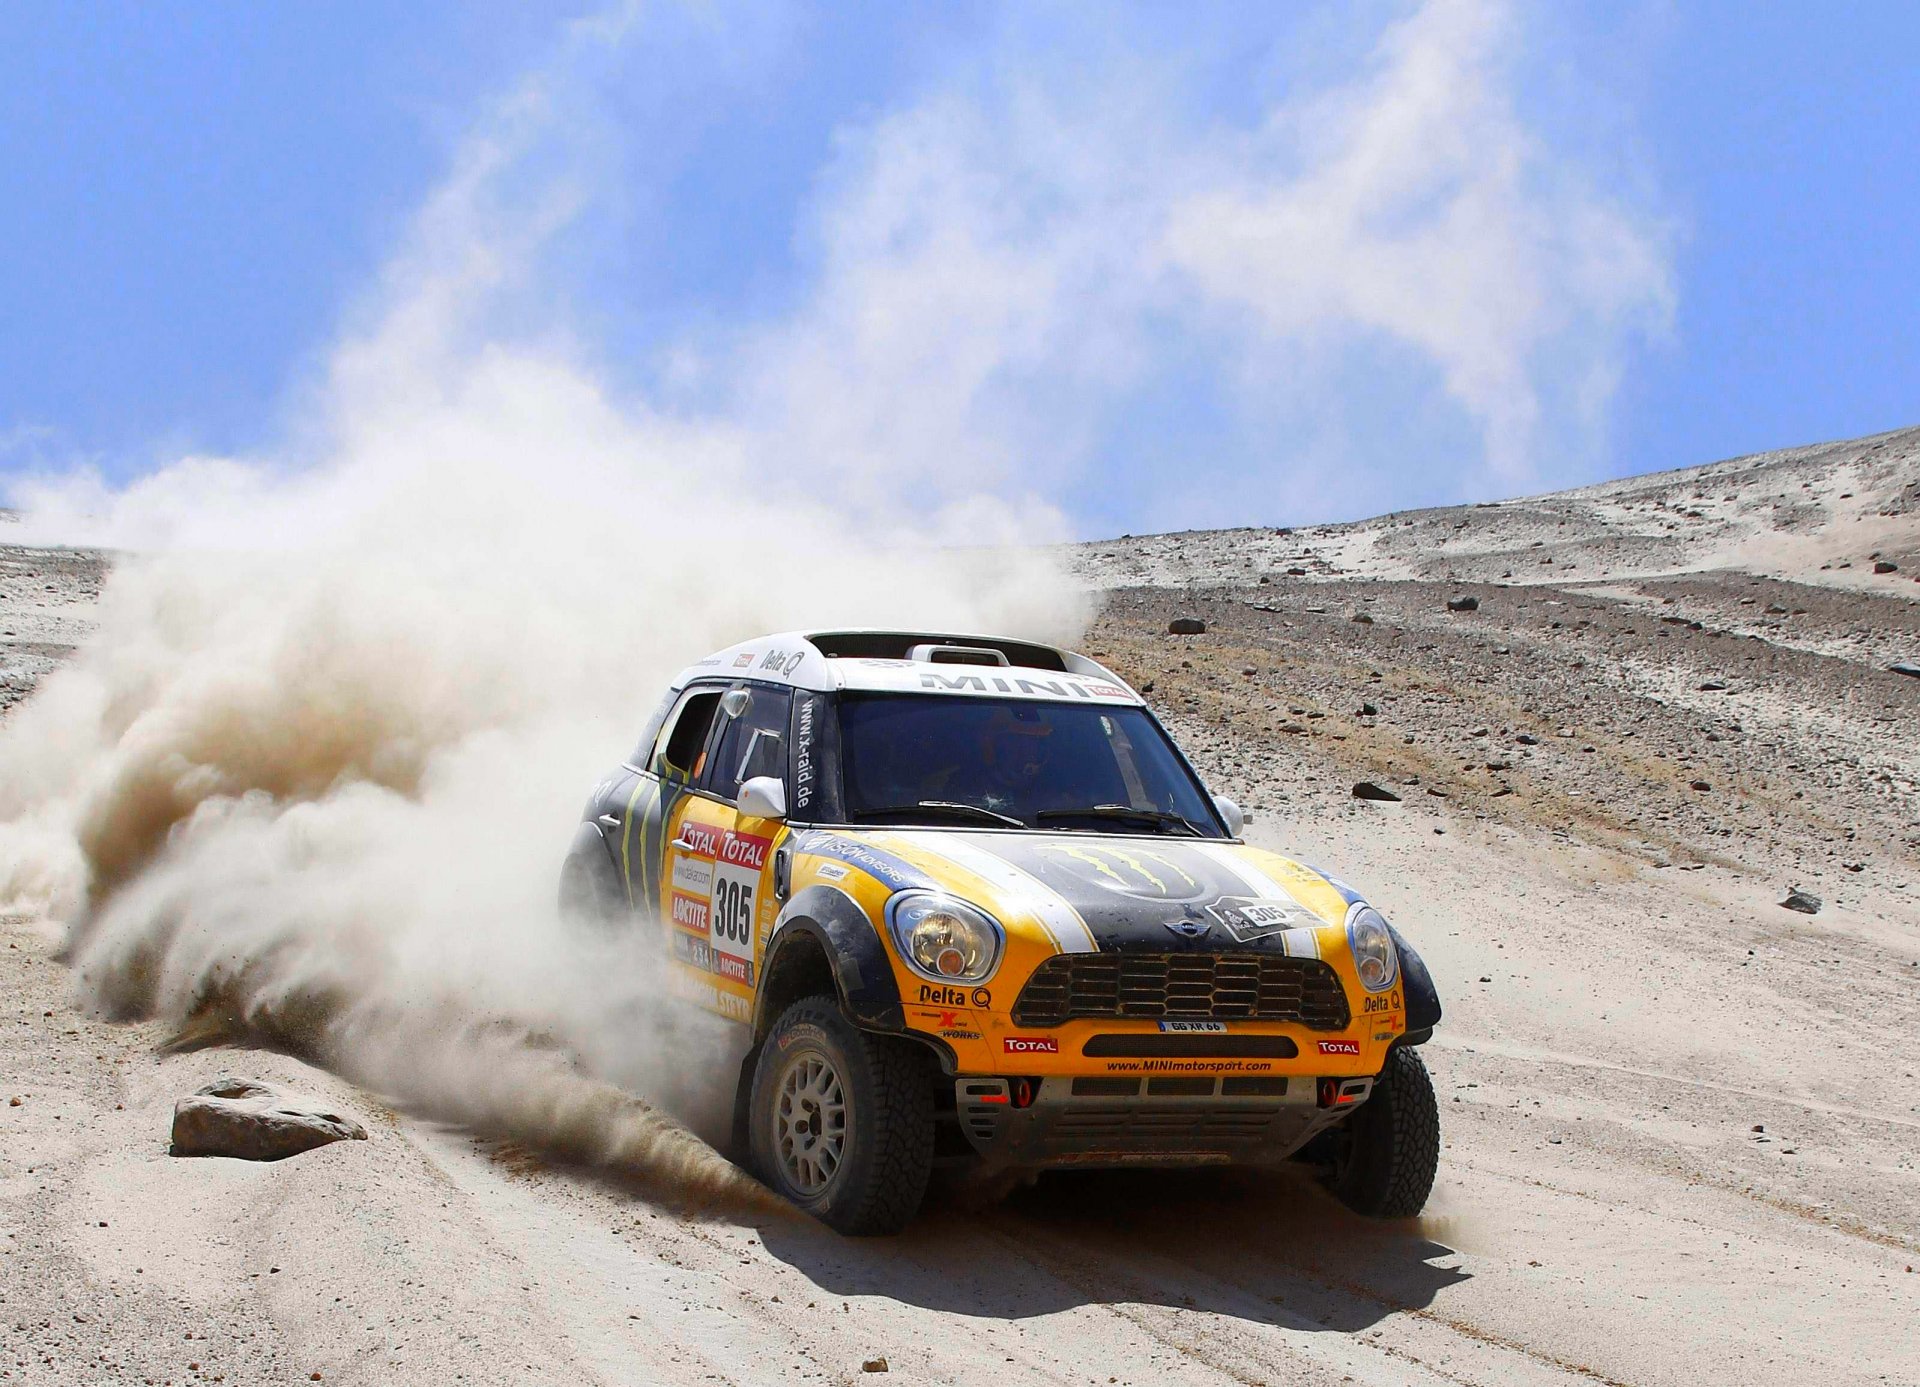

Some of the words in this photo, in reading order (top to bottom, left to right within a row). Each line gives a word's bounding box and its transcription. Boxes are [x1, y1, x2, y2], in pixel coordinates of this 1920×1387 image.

[760, 650, 786, 671] Delta
[920, 673, 1091, 697] MINI
[798, 699, 814, 808] www.x-raid.de
[722, 832, 764, 866] TOTAL
[673, 897, 707, 928] LOCTITE
[715, 878, 752, 946] 305
[1250, 906, 1287, 923] 305
[721, 957, 745, 979] LOCTITE
[920, 985, 965, 1005] Delta
[1365, 995, 1388, 1012] Delta
[943, 1030, 980, 1039] WORKS
[1171, 1022, 1187, 1030] GG
[1188, 1022, 1205, 1030] XR
[1206, 1022, 1220, 1030] 66
[1006, 1039, 1057, 1051] TOTAL
[1319, 1042, 1358, 1053] TOTAL
[1107, 1060, 1272, 1072] www.MINImotorsport.com
